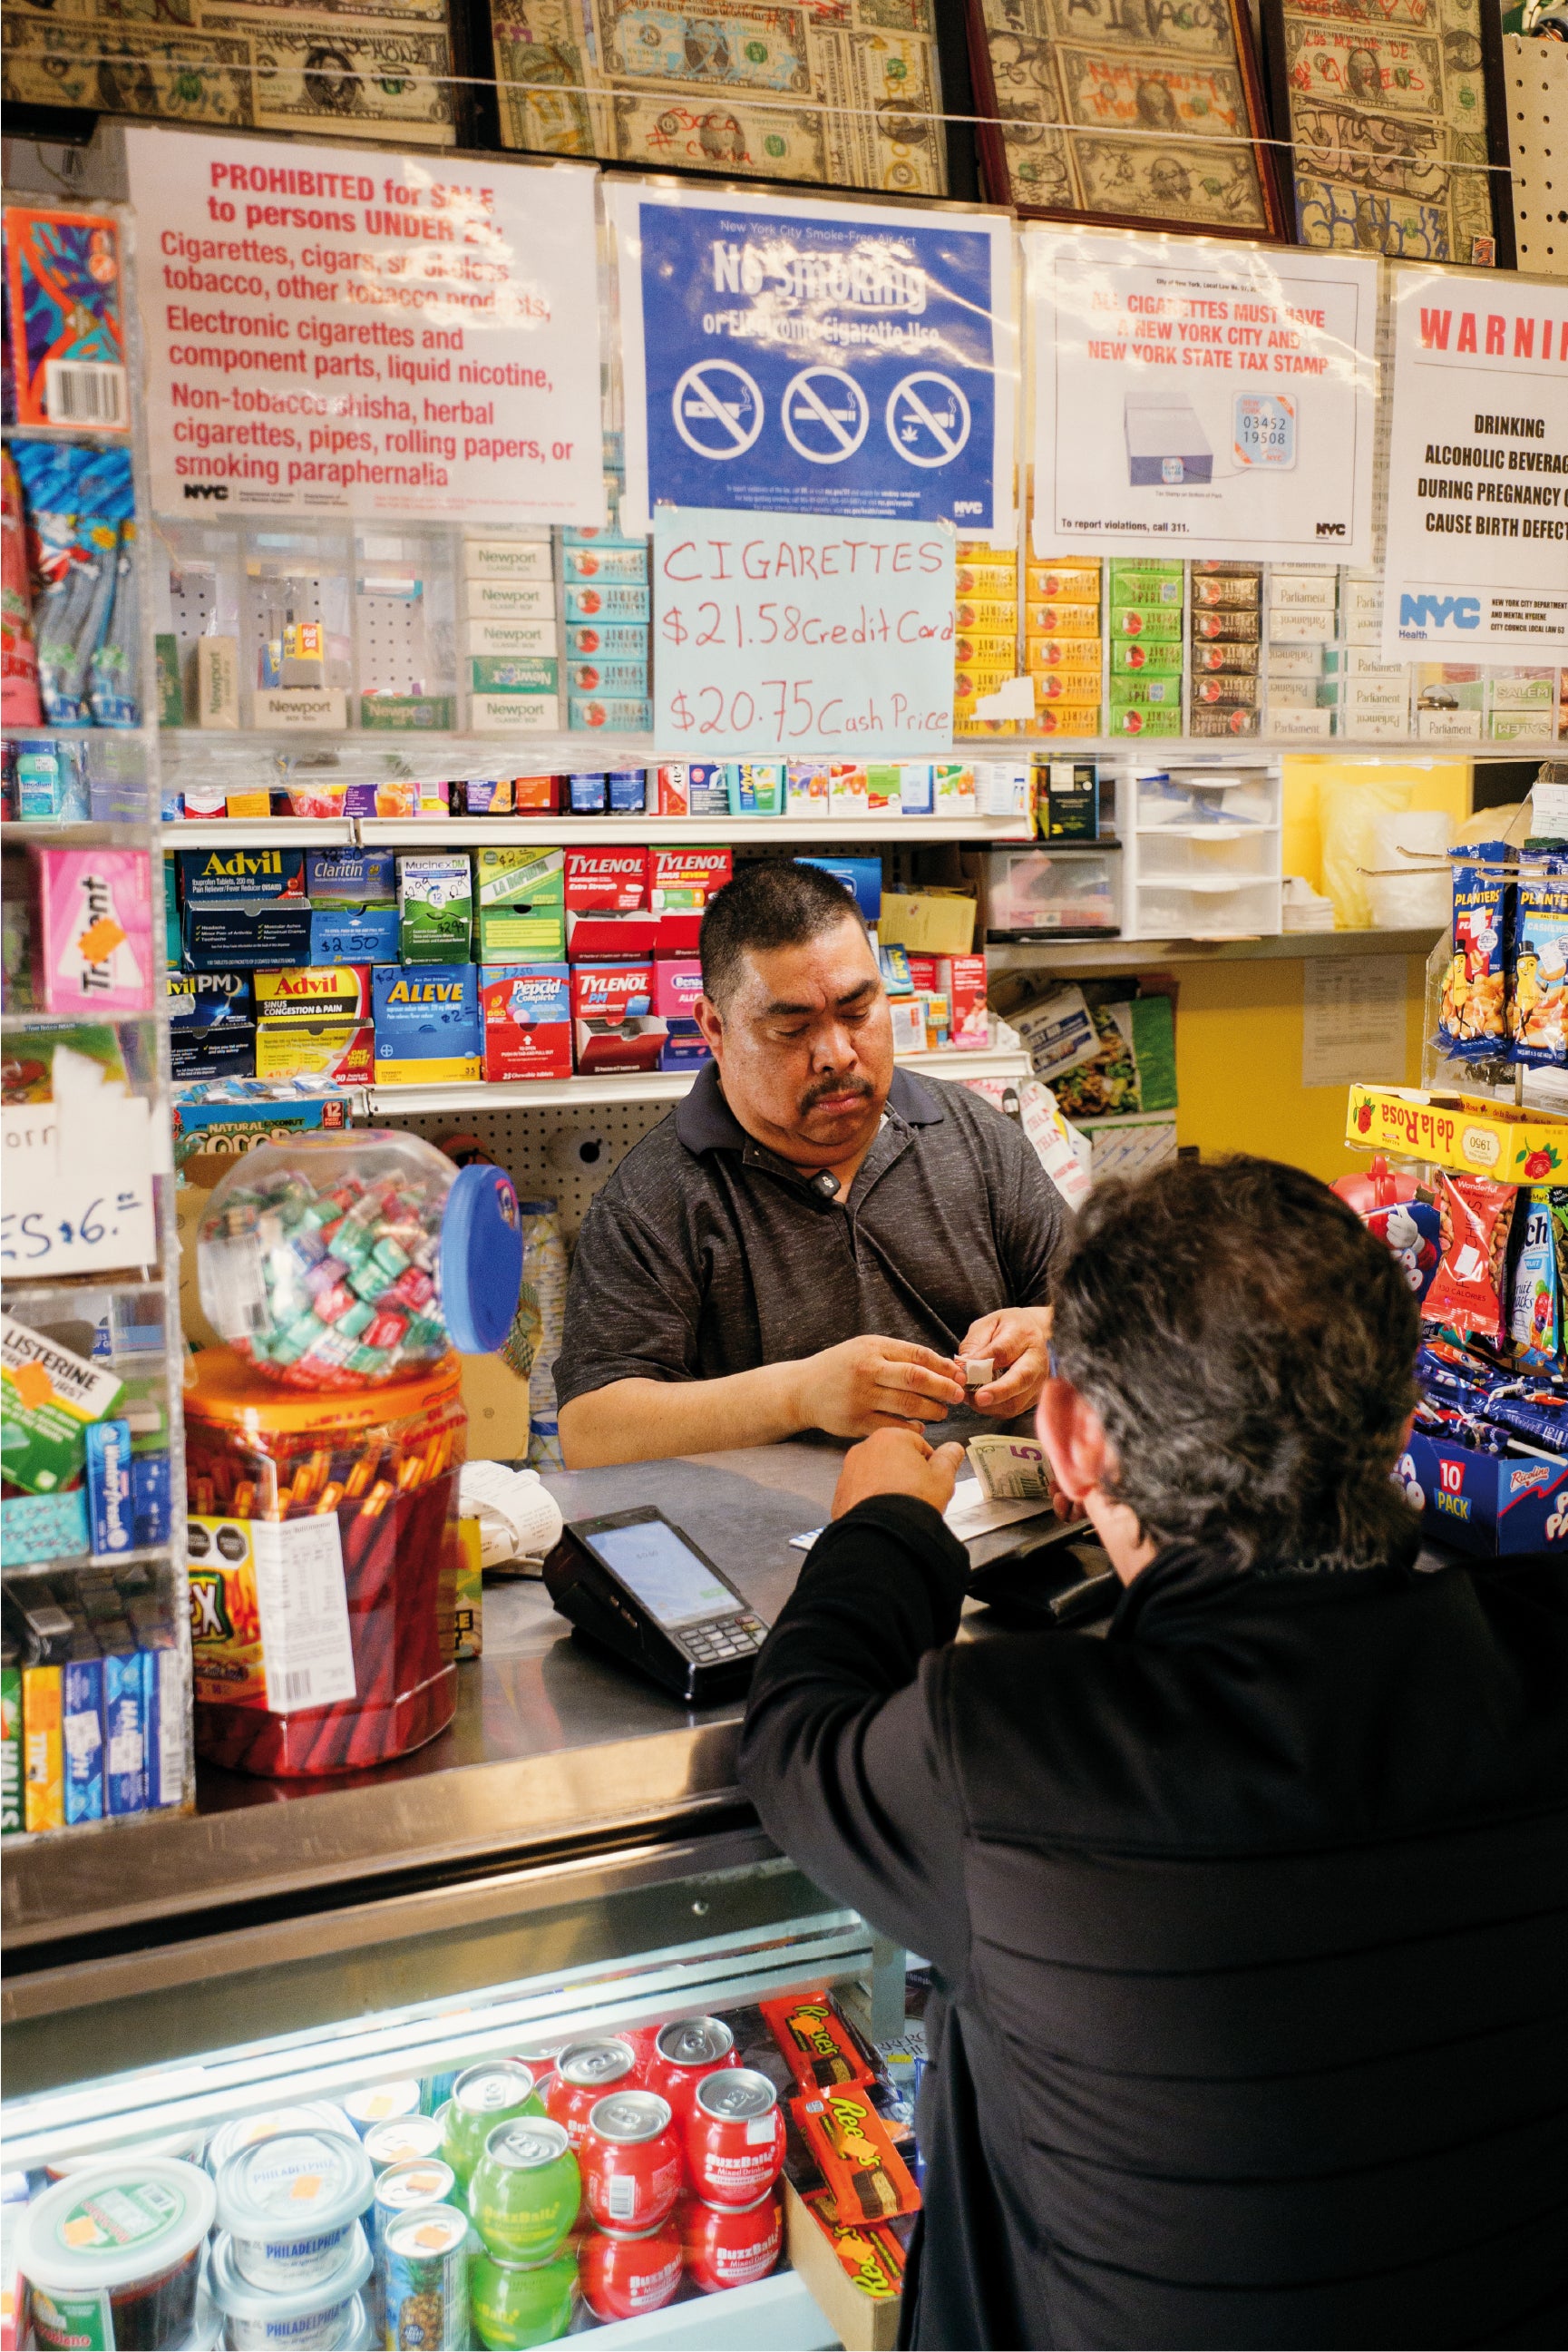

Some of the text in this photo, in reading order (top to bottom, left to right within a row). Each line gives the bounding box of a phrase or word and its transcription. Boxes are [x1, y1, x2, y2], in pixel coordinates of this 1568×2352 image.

[210, 161, 422, 206] PROHIBITED for
[208, 195, 454, 241] to persons UNDER
[720, 220, 917, 248] New York City Smoke-Free Air Act
[161, 230, 382, 275] Cigarettes, cigars,
[712, 240, 764, 296] No
[163, 265, 439, 308] tobacco, other tobacco
[1127, 295, 1229, 320] CIGAETTES
[1234, 303, 1278, 325] MUST
[1284, 308, 1326, 328] HAVE
[166, 305, 463, 350] Electronic cigarettes and
[703, 314, 725, 334] or
[1117, 319, 1301, 350] A NEW YORK CITY AND
[1088, 339, 1329, 376] NEW YORK STATE TAX STAMP
[169, 345, 553, 392] component parts, liquid nicotine,
[170, 382, 494, 425] Non-tobacco shisha, herbal
[1243, 415, 1286, 431] 03452
[1475, 414, 1545, 439] DRINKING
[172, 416, 574, 464] cigarettes, pipes, rolling papers, or
[1243, 431, 1286, 444] 19508
[1425, 444, 1505, 470] ALCOHOLIC
[174, 453, 449, 488] smoking paraphernalia
[183, 483, 229, 501] NYC
[1417, 478, 1562, 507] DURING PREGNANCY
[953, 501, 983, 515] NYC
[1061, 518, 1190, 533] To report violations, call 311.
[1316, 522, 1346, 536] NYC
[1426, 512, 1472, 534] CAUSE
[1475, 516, 1519, 538] BIRTH
[478, 550, 537, 565] Newport
[663, 540, 943, 581] CIGARETTES
[482, 589, 540, 603] Newport
[1281, 589, 1326, 604] Parliament
[1492, 598, 1568, 610] NEW YORK CITY DEPARTMENT
[1399, 593, 1481, 629] NYC
[1491, 610, 1546, 620] AND MENTAL HYGIENE
[483, 627, 542, 641] Newport
[662, 602, 891, 648] $21.58 Credit
[1398, 629, 1427, 639] Health
[1490, 623, 1565, 634] CITY COUNCIL LOCAL LAW 63
[1357, 690, 1400, 704] Parliament
[1498, 688, 1549, 698] SALEM
[268, 699, 331, 715] Newport
[486, 702, 545, 717] Newport
[671, 680, 949, 742] $20.75 Cash Price
[1429, 721, 1472, 736] Parliament
[1498, 724, 1550, 736] SALEM
[201, 850, 282, 876] Advil
[314, 863, 363, 878] Claritin
[405, 859, 464, 870] Mucinex DM
[568, 854, 644, 875] TYLENOL
[655, 852, 727, 872] TYLENOL
[1455, 888, 1501, 907] PLANTERS
[1520, 890, 1568, 905] PLANTE
[81, 876, 111, 992] Trent
[321, 935, 379, 952] $2.50
[167, 973, 231, 996] vil PM
[274, 974, 337, 996] Advil
[386, 981, 463, 1004] ALEVE
[512, 979, 561, 997] Pepcid
[579, 974, 648, 995] TYLENOL
[264, 1000, 287, 1009] SINUS
[516, 994, 556, 1004] Complete
[589, 992, 609, 1004] PM
[264, 1004, 343, 1016] CONGESTION PAIN
[326, 1101, 342, 1117] 12
[209, 1117, 306, 1133] NATURAL COCONUT
[1381, 1103, 1419, 1145] Rosa
[1469, 1137, 1491, 1151] 1950
[1457, 1180, 1498, 1194] Wonderful
[1451, 1286, 1486, 1301] CALORIES
[4, 1329, 101, 1392] LISTERINE
[1009, 1445, 1043, 1461] 5
[1440, 1462, 1461, 1491] 10
[1510, 1466, 1550, 1490] Ricolino
[1437, 1492, 1469, 1520] PACK
[28, 1730, 48, 1783] HALL
[794, 2004, 840, 2061] Rese's
[829, 2096, 881, 2169] Ree's
[706, 2149, 775, 2170] BuzzBallz
[717, 2165, 765, 2176] Mixed Drinks
[266, 2230, 341, 2260] PHILADELPHIA
[716, 2231, 779, 2260] BuzzBallz
[730, 2256, 754, 2268] Mixed
[266, 2306, 341, 2337] PHILADELPHIA
